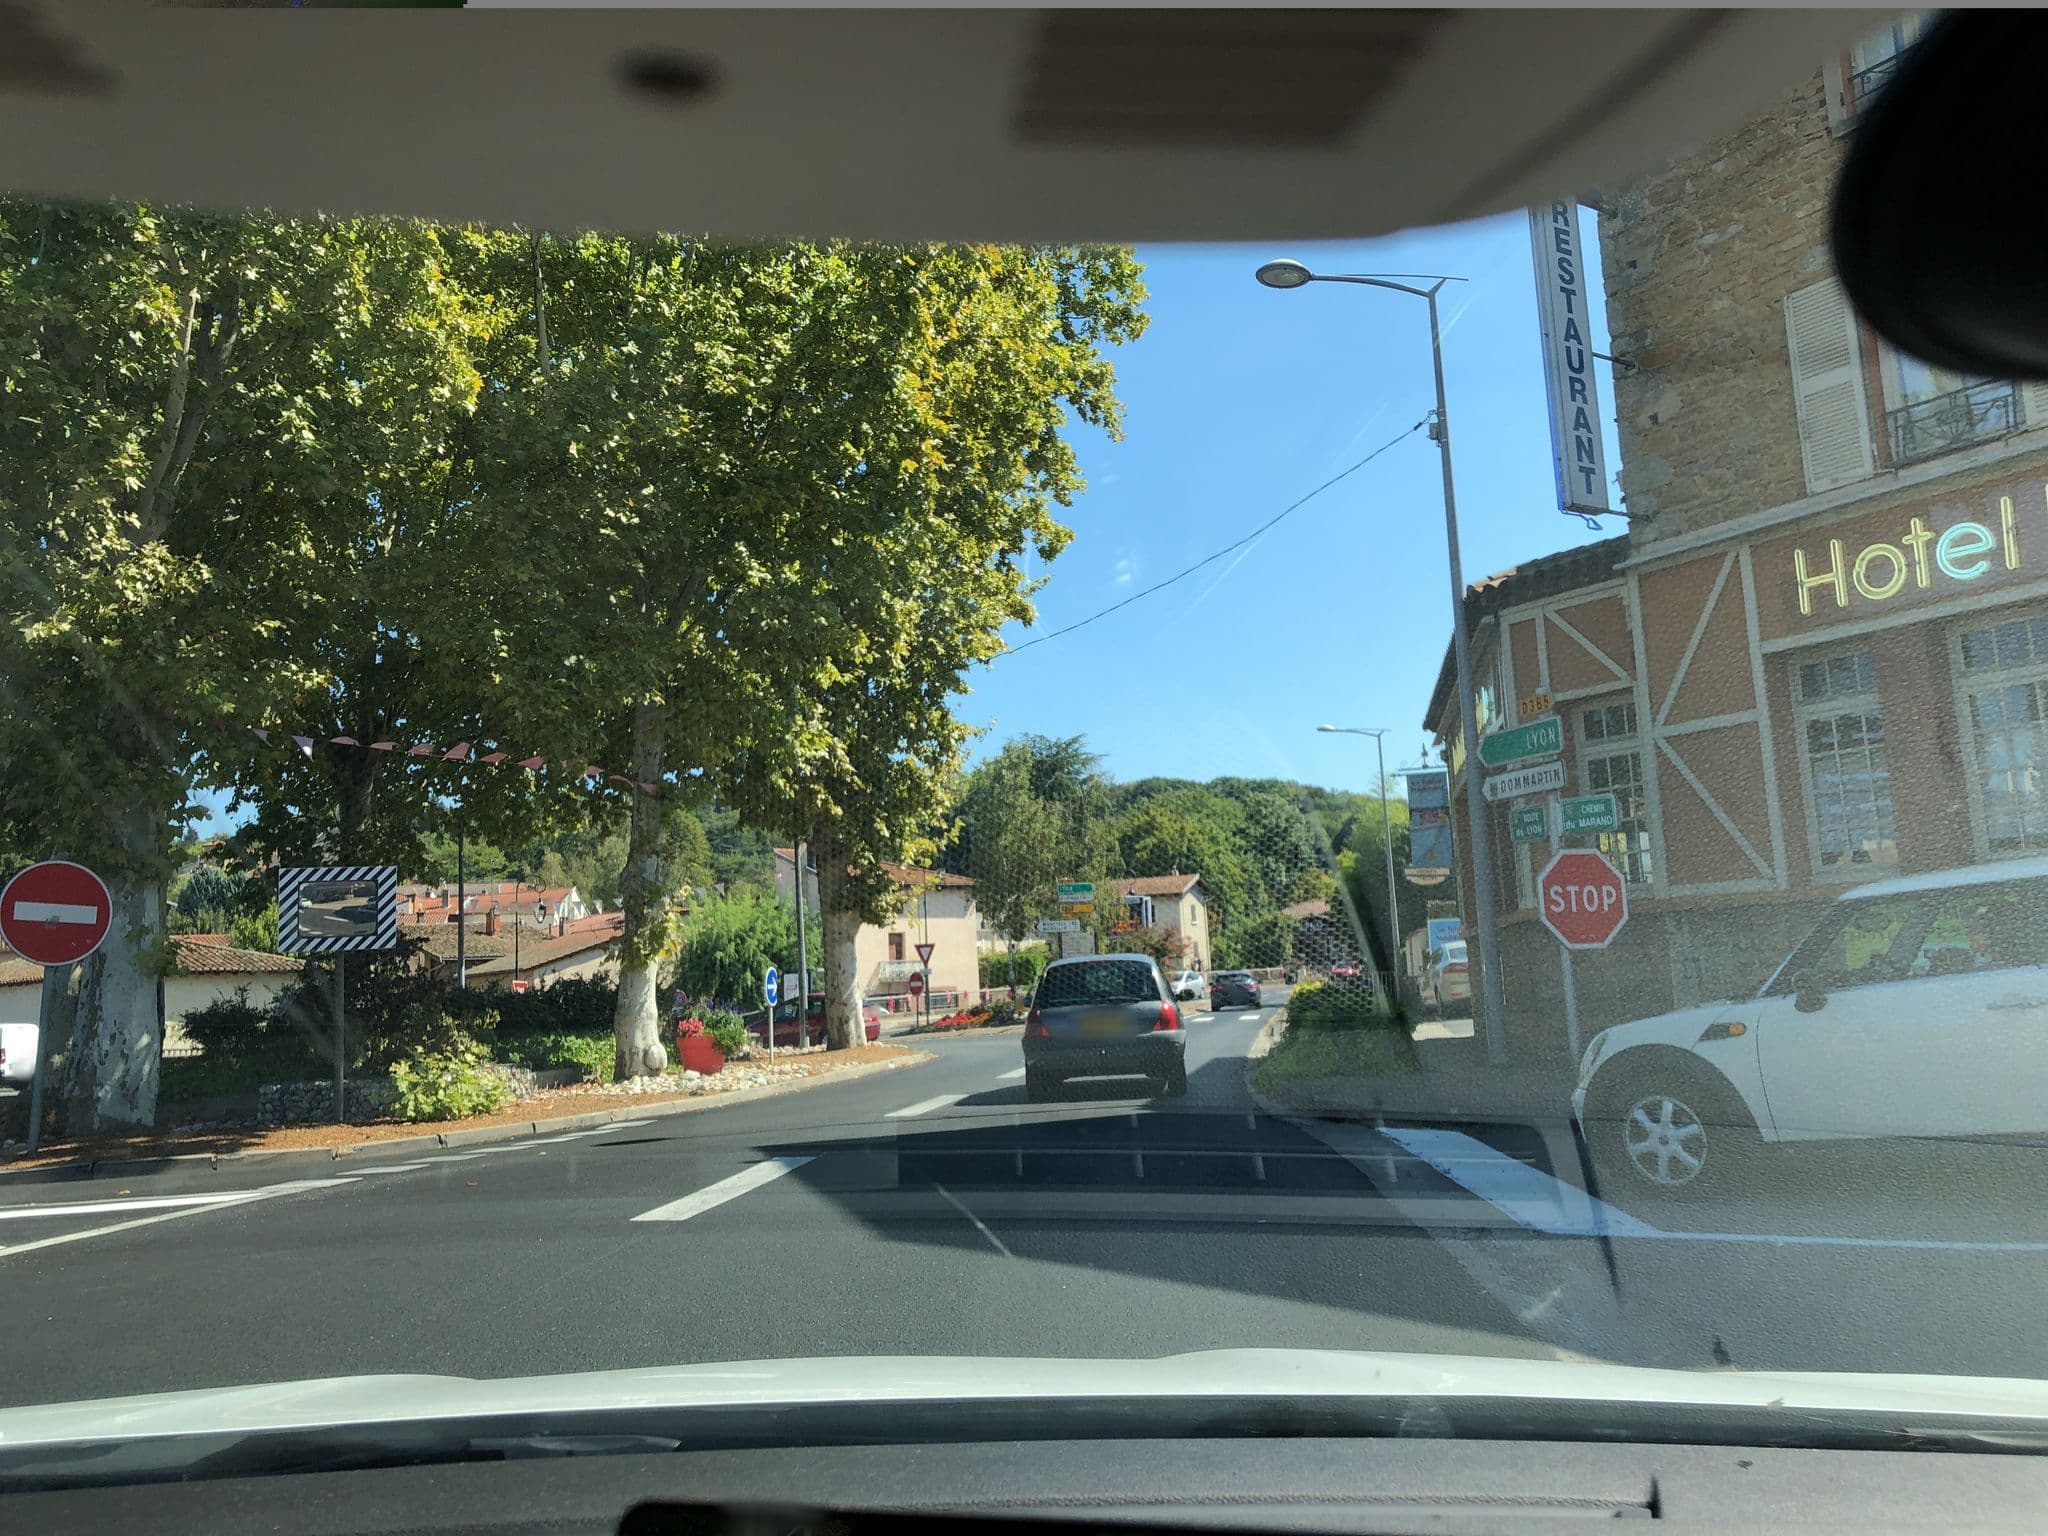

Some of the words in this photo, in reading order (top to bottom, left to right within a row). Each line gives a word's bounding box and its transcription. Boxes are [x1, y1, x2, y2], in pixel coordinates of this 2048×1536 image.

[1551, 200, 1596, 496] RESTAURANT
[1794, 495, 2020, 616] Hotel
[1526, 727, 1556, 750] LYON
[1500, 767, 1561, 793] DOMMARTIN
[1580, 803, 1605, 814] CHEMIN
[1526, 824, 1542, 835] LYON
[1550, 884, 1617, 913] STOP
